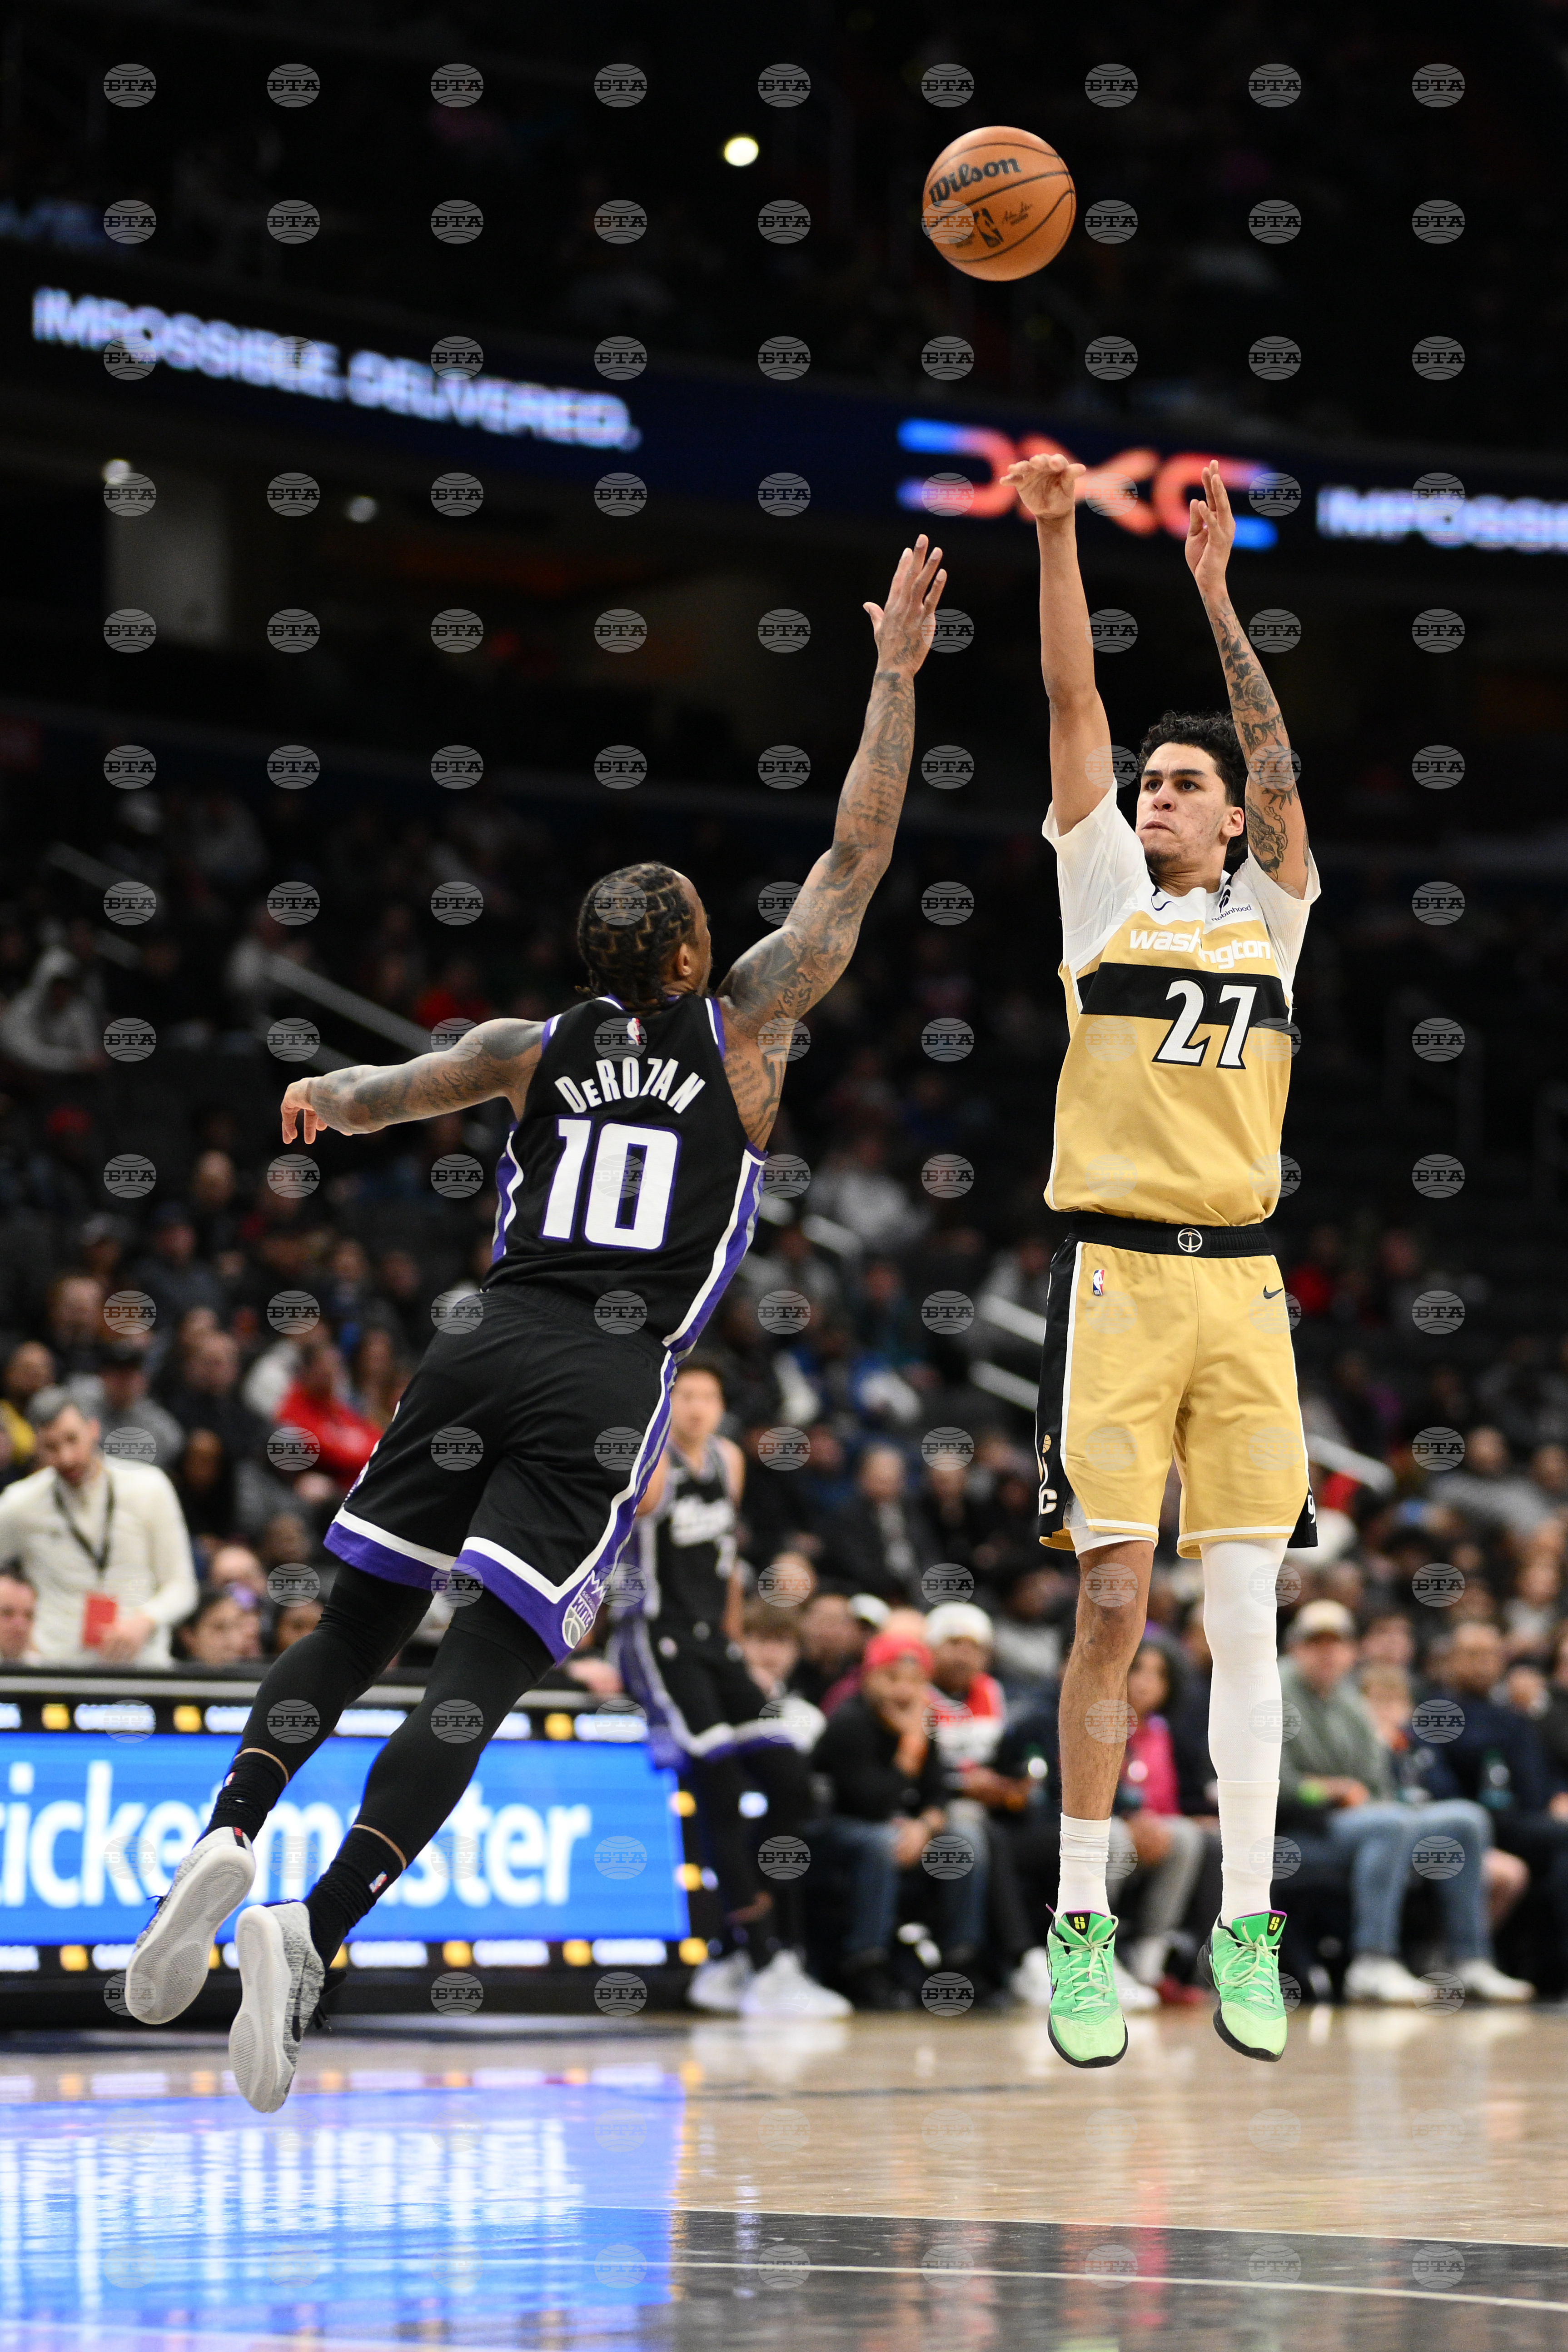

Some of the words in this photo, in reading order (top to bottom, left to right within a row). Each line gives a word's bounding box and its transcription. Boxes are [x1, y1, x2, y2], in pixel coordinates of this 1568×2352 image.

[928, 156, 1021, 208] Wilson
[1129, 927, 1271, 970] washngton
[1211, 904, 1252, 922] Robinhood
[1153, 978, 1258, 1069] 27
[540, 1116, 681, 1251] 10
[0, 1760, 592, 1909] ickemster
